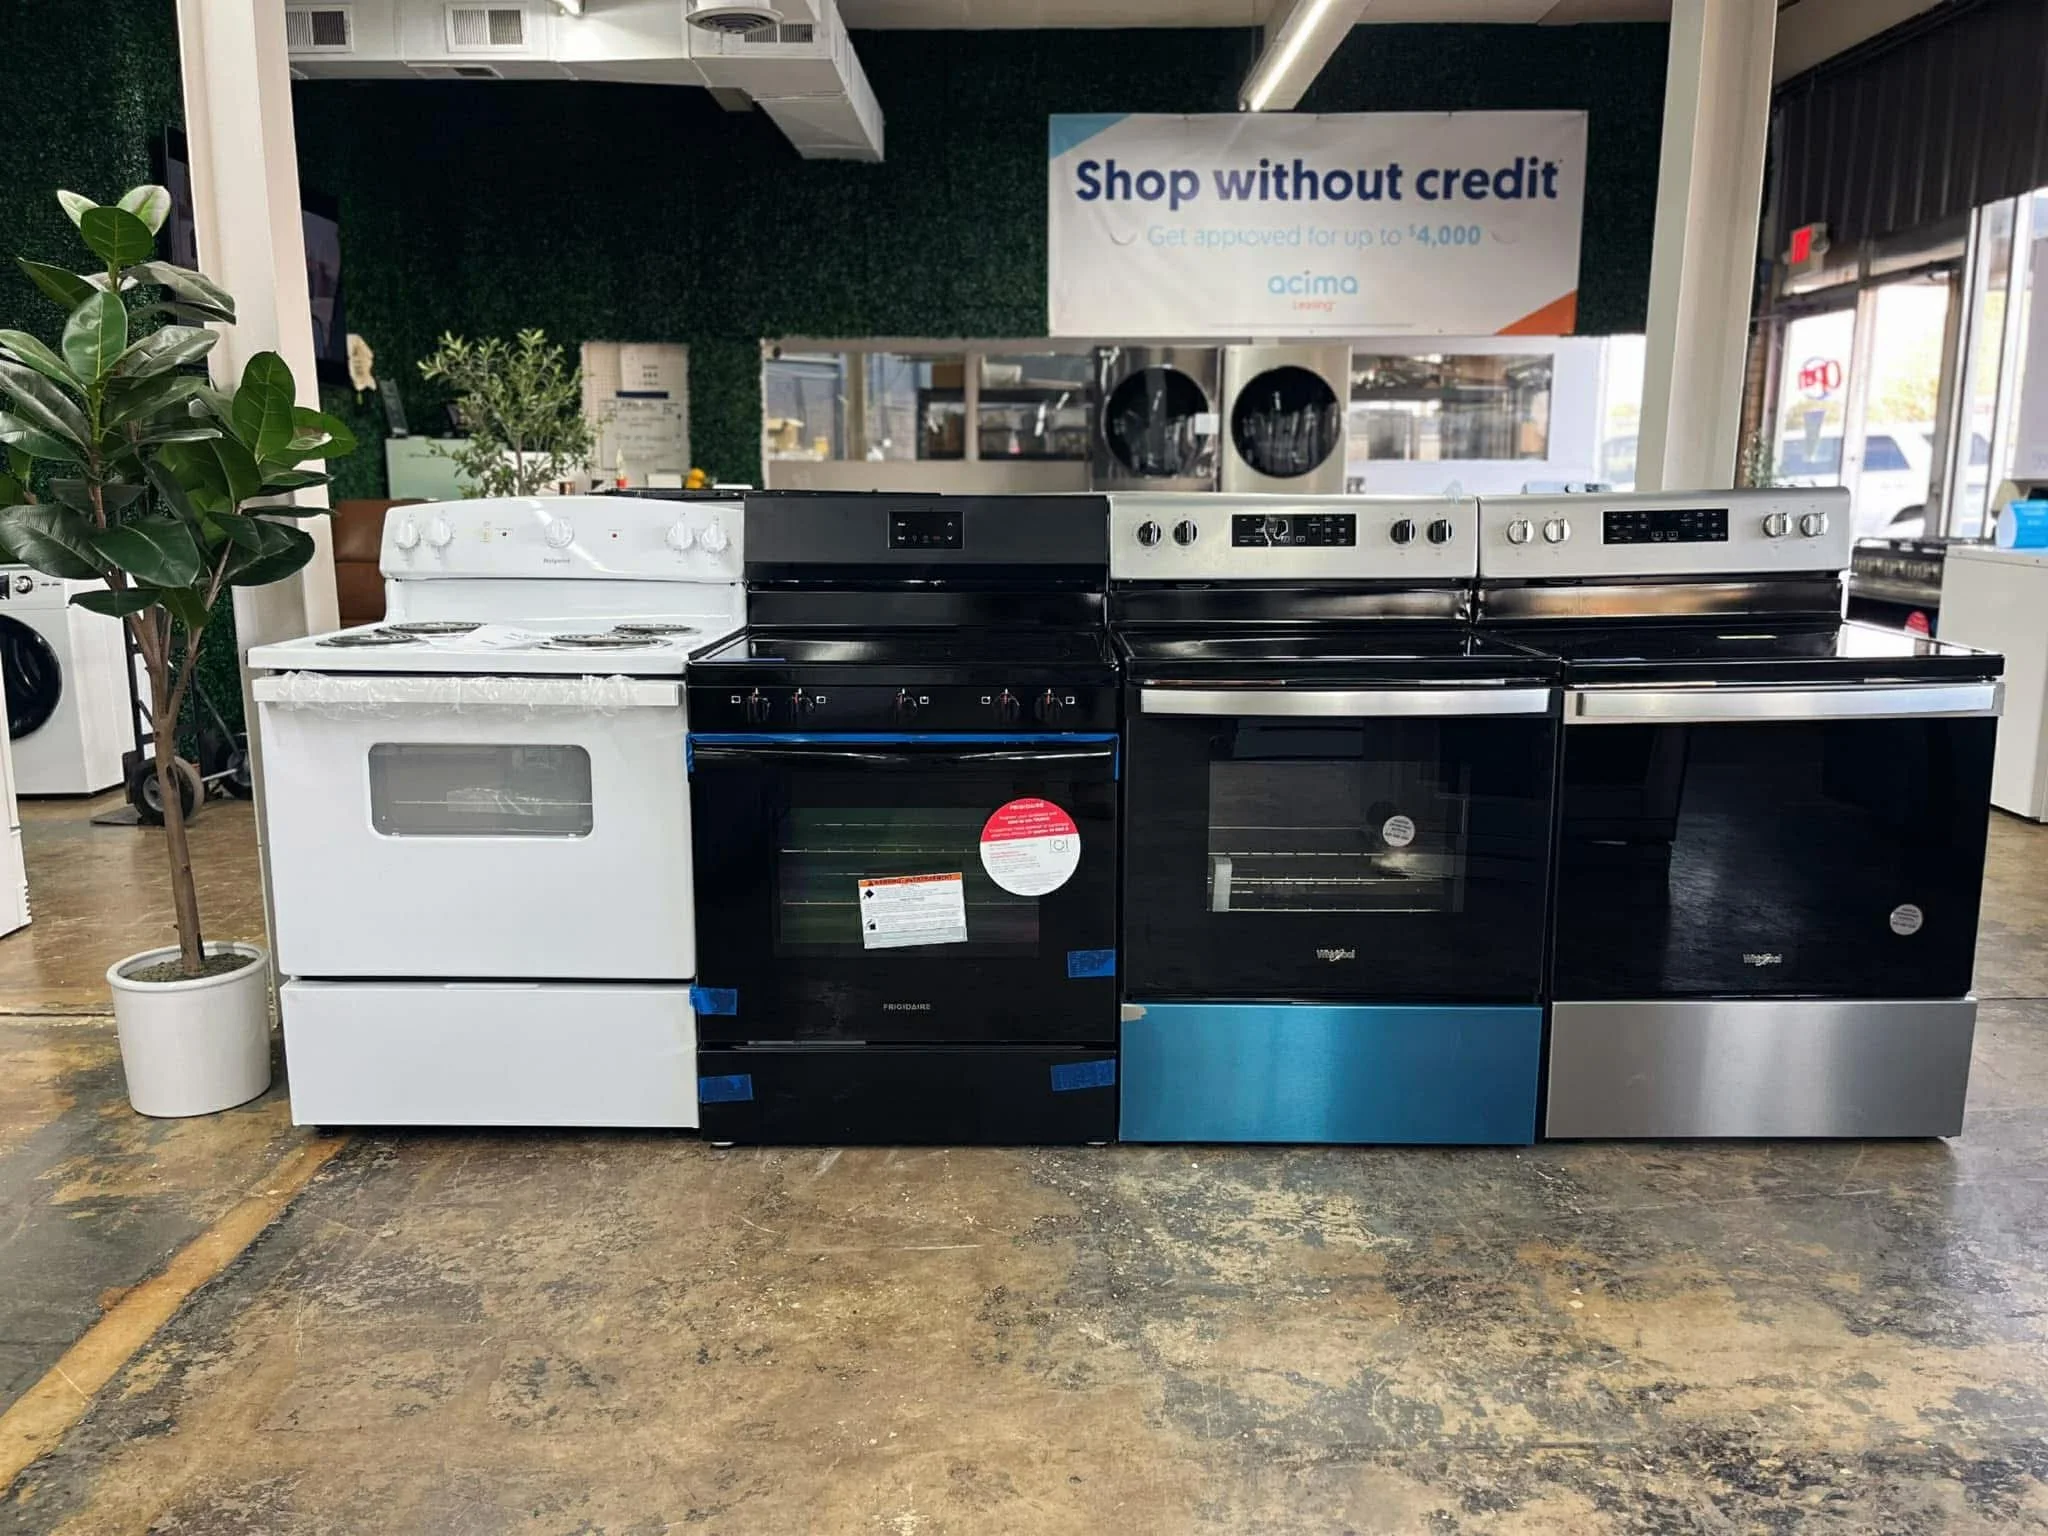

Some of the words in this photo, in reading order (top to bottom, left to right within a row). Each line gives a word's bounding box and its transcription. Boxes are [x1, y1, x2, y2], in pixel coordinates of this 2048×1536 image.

[1076, 159, 1200, 211] Shop
[1213, 158, 1403, 201] without
[1147, 224, 1186, 246] Get
[1194, 225, 1301, 249] approved
[1307, 225, 1335, 246] for
[1344, 229, 1374, 251] up
[1380, 226, 1402, 246] to
[1409, 223, 1481, 248] $4,000
[1267, 269, 1359, 294] acima
